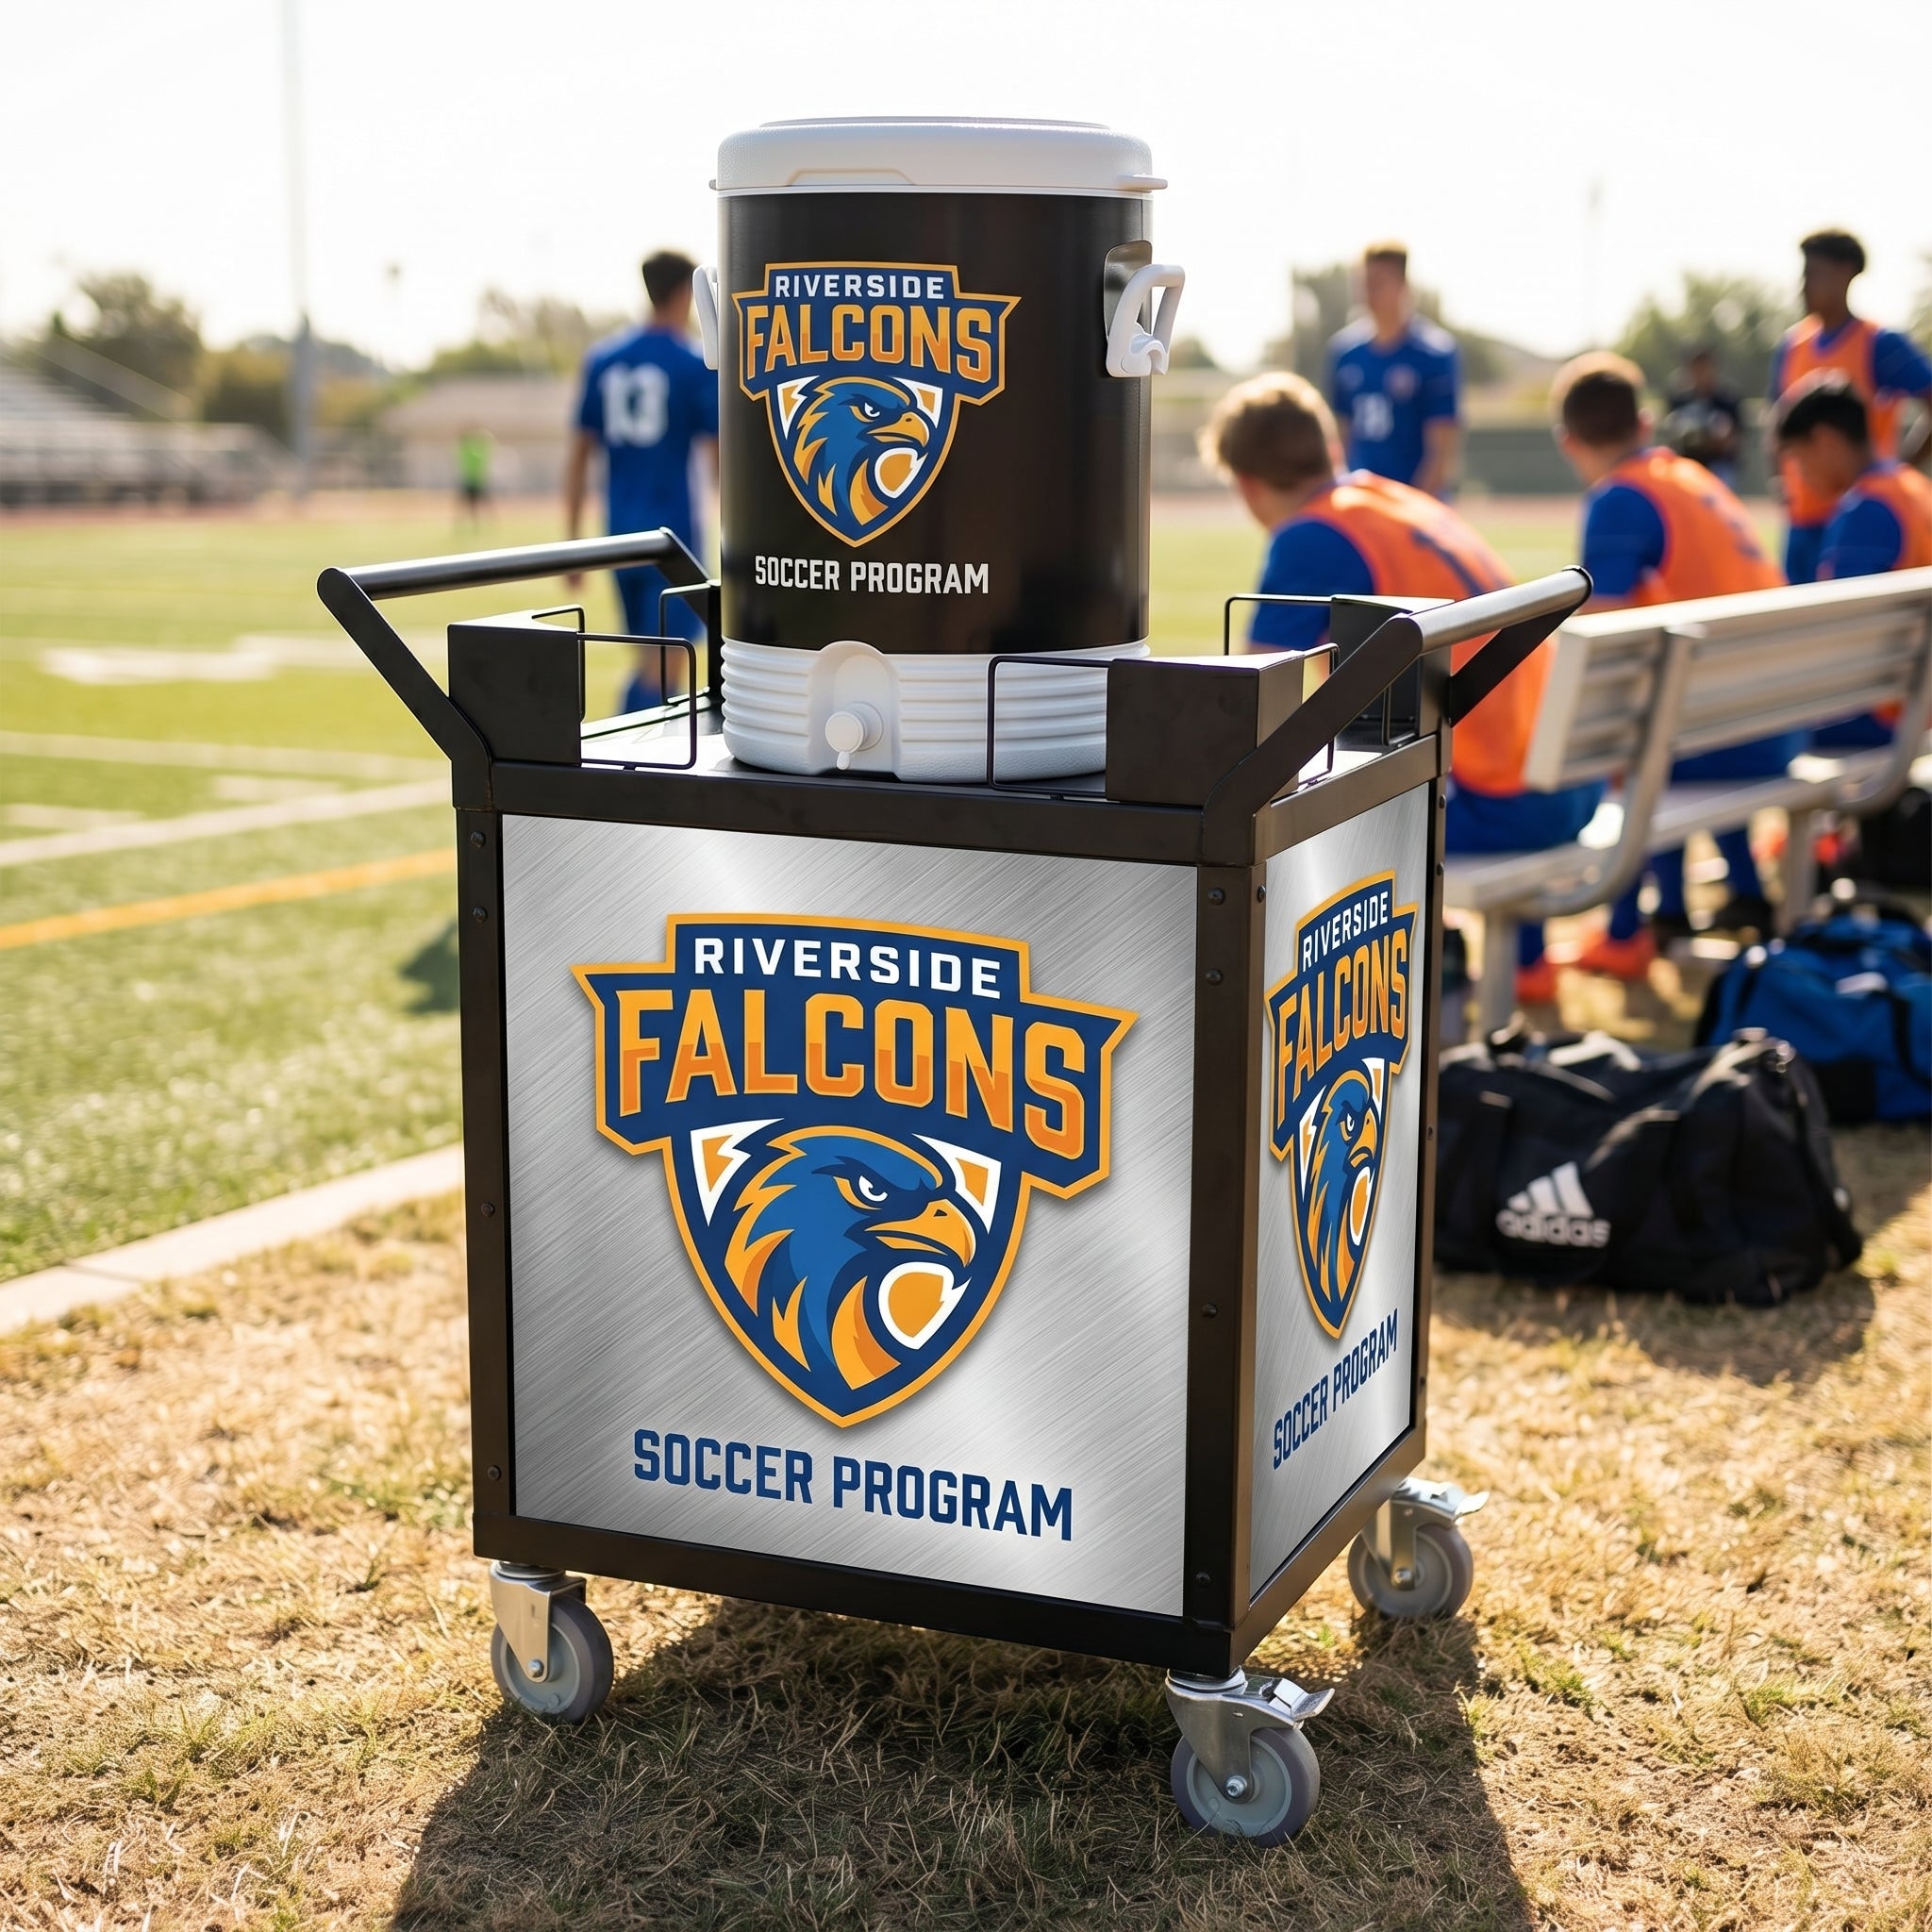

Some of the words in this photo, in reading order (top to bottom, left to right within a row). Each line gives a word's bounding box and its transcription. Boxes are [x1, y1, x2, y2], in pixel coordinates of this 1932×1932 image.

[774, 275, 943, 299] RIVERSIDE
[746, 304, 991, 383] FALCONS
[755, 555, 840, 591] SOCCER
[850, 561, 989, 594] PROGRAM
[694, 938, 1001, 999] RIVERSIDE
[1302, 890, 1389, 971] RIVERSIDE
[1277, 927, 1407, 1130] FALCONS
[618, 989, 1085, 1160] FALCONS
[1496, 1209, 1611, 1248] adidas
[1273, 1374, 1328, 1472] SOCCER
[1332, 1307, 1398, 1412] PROGRAM
[633, 1428, 813, 1504] SOCCER
[832, 1456, 1073, 1541] PROGRAM
